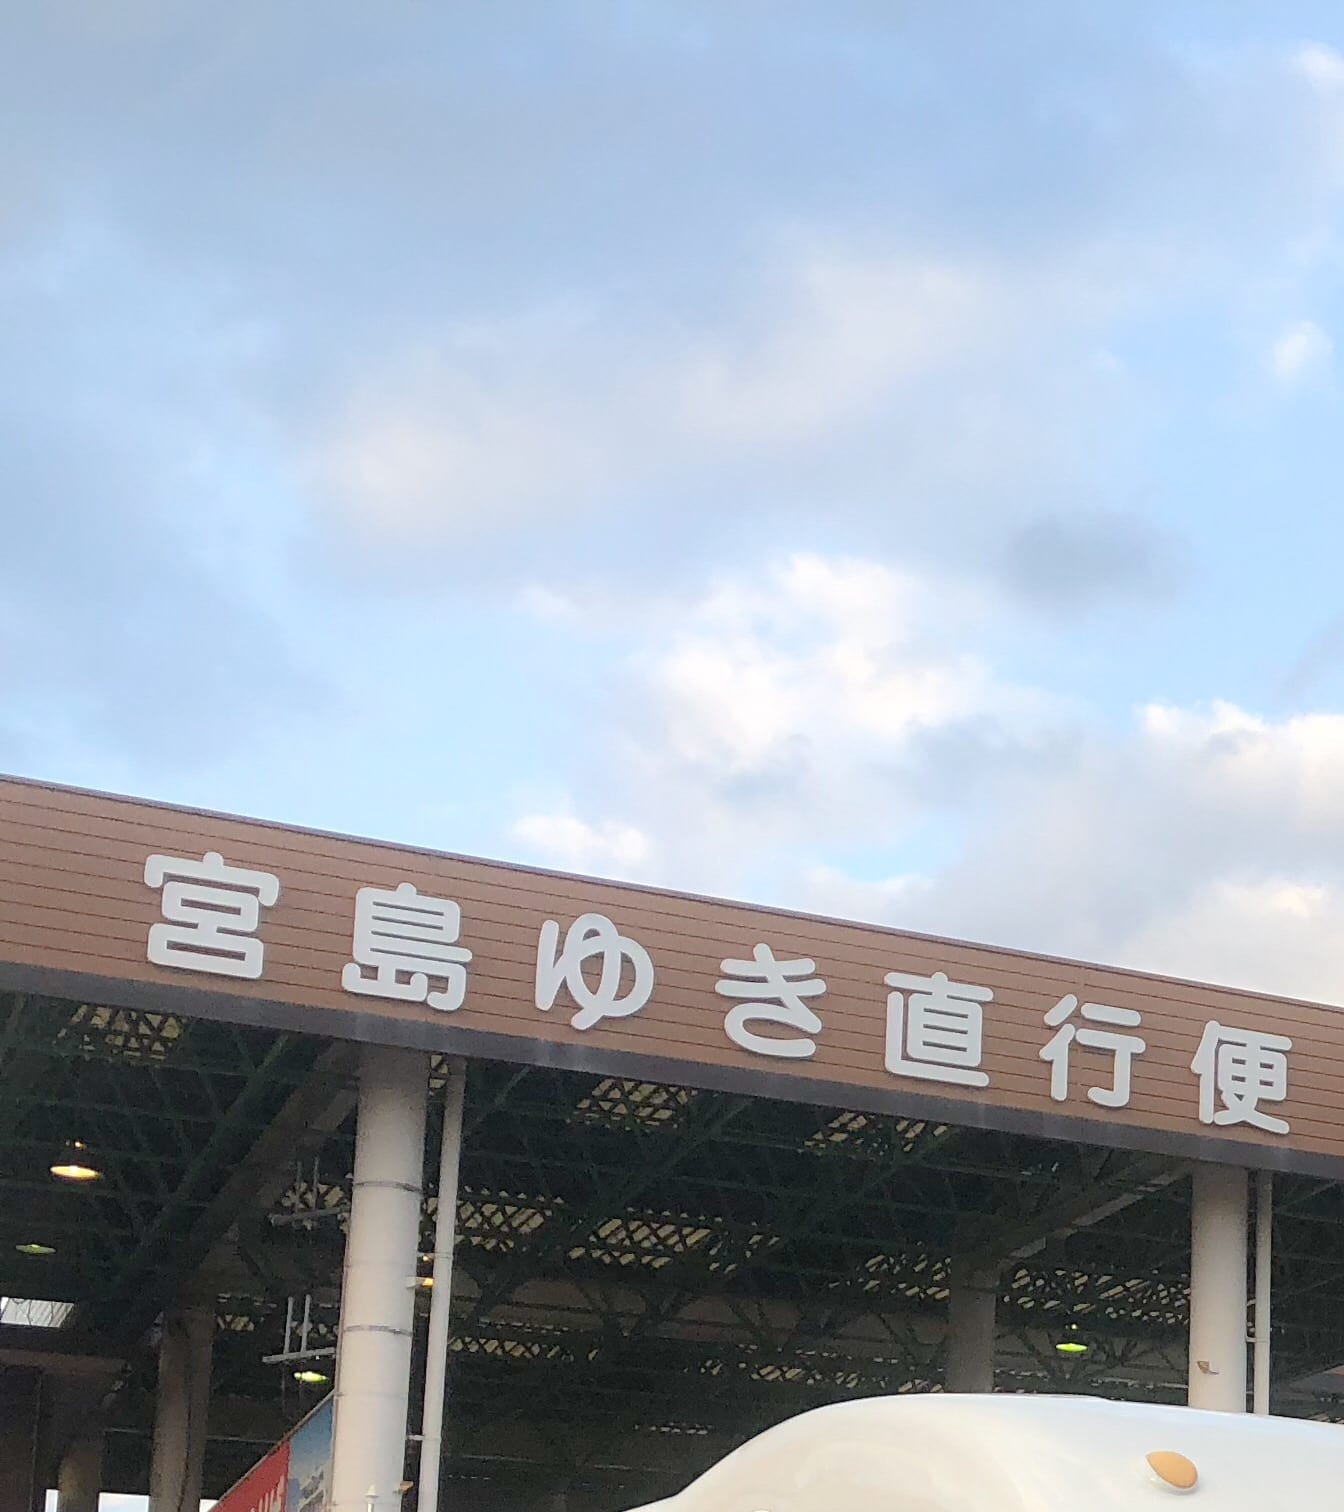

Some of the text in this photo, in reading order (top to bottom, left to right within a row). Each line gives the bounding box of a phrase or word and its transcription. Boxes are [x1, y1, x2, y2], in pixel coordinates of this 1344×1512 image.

[143, 851, 1294, 1136] 宮島ゆき直行便
